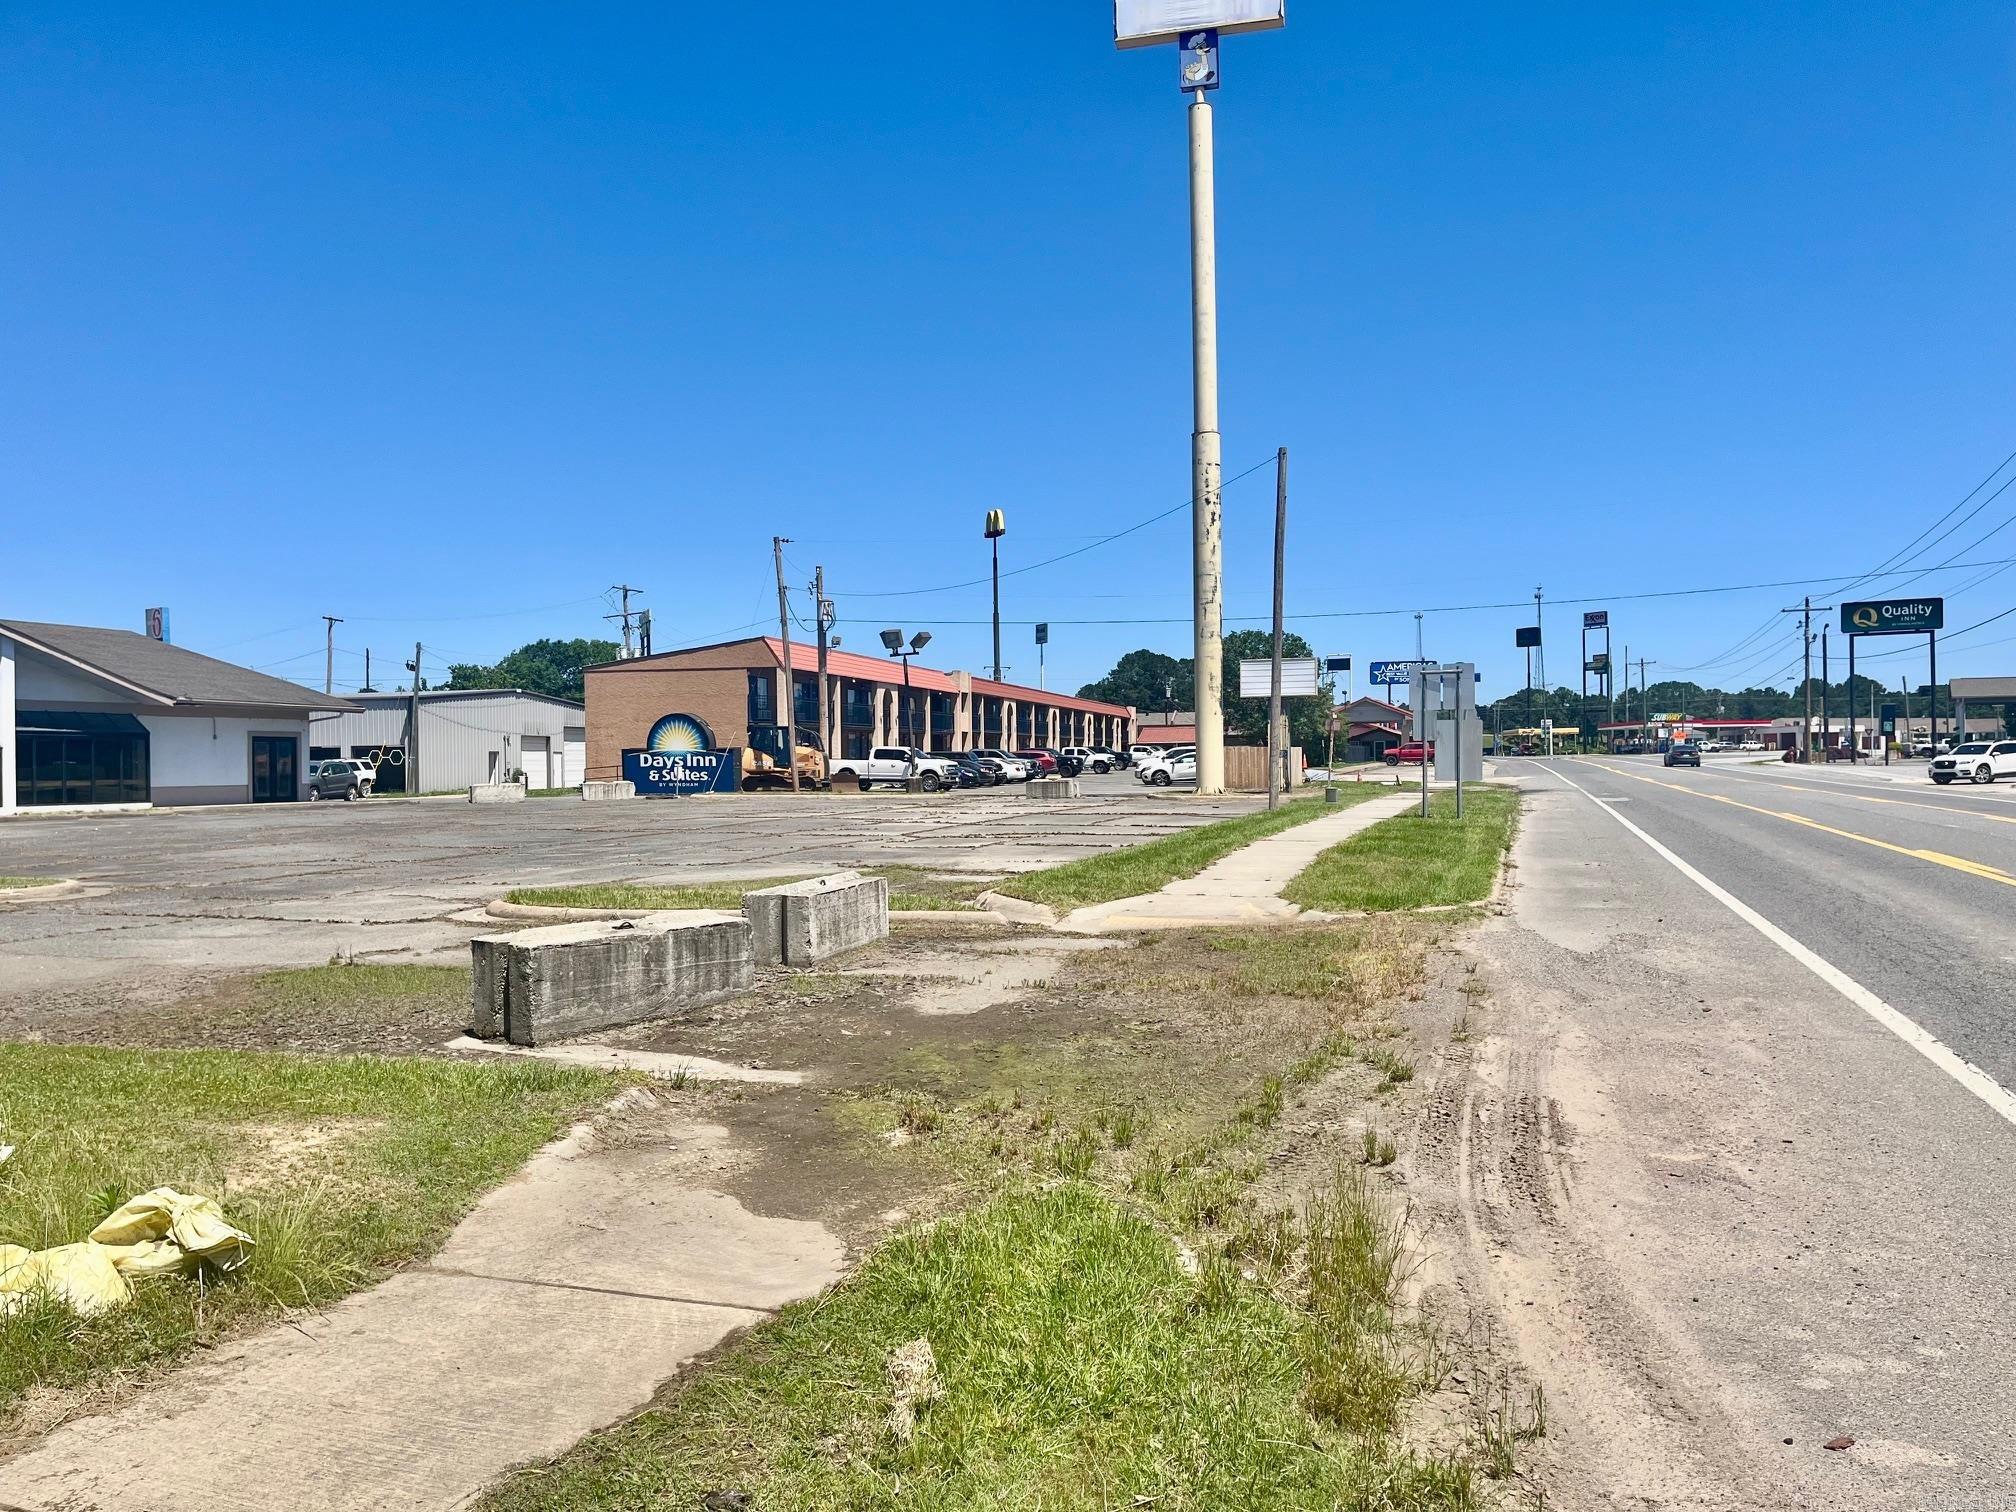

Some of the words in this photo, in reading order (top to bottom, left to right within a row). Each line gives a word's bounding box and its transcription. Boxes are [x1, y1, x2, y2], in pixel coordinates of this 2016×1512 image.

[1882, 604, 1932, 618] Quality
[152, 609, 161, 638] 6
[640, 754, 684, 768] Days
[686, 753, 716, 767] Inn
[649, 770, 659, 781] &
